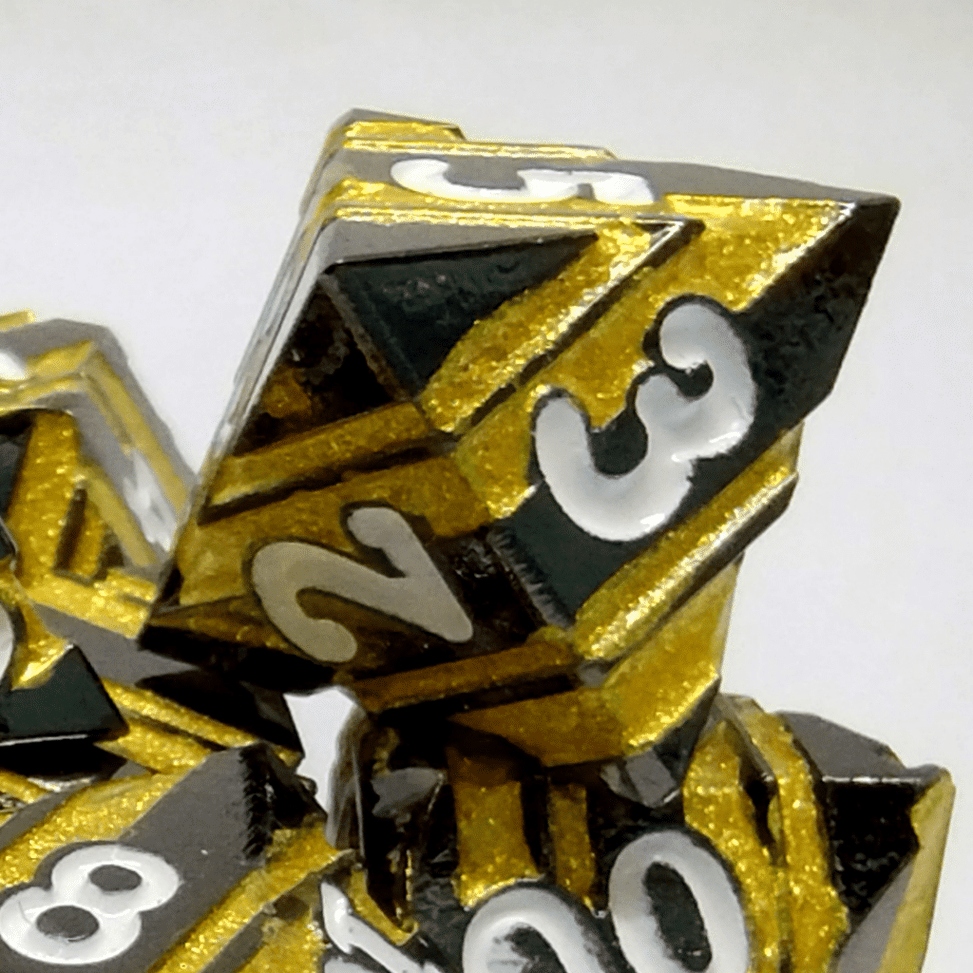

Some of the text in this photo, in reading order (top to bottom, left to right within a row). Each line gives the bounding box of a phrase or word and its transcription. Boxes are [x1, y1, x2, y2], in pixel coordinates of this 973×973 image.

[390, 158, 654, 205] 5
[535, 302, 757, 542] 3
[251, 506, 473, 663] 2
